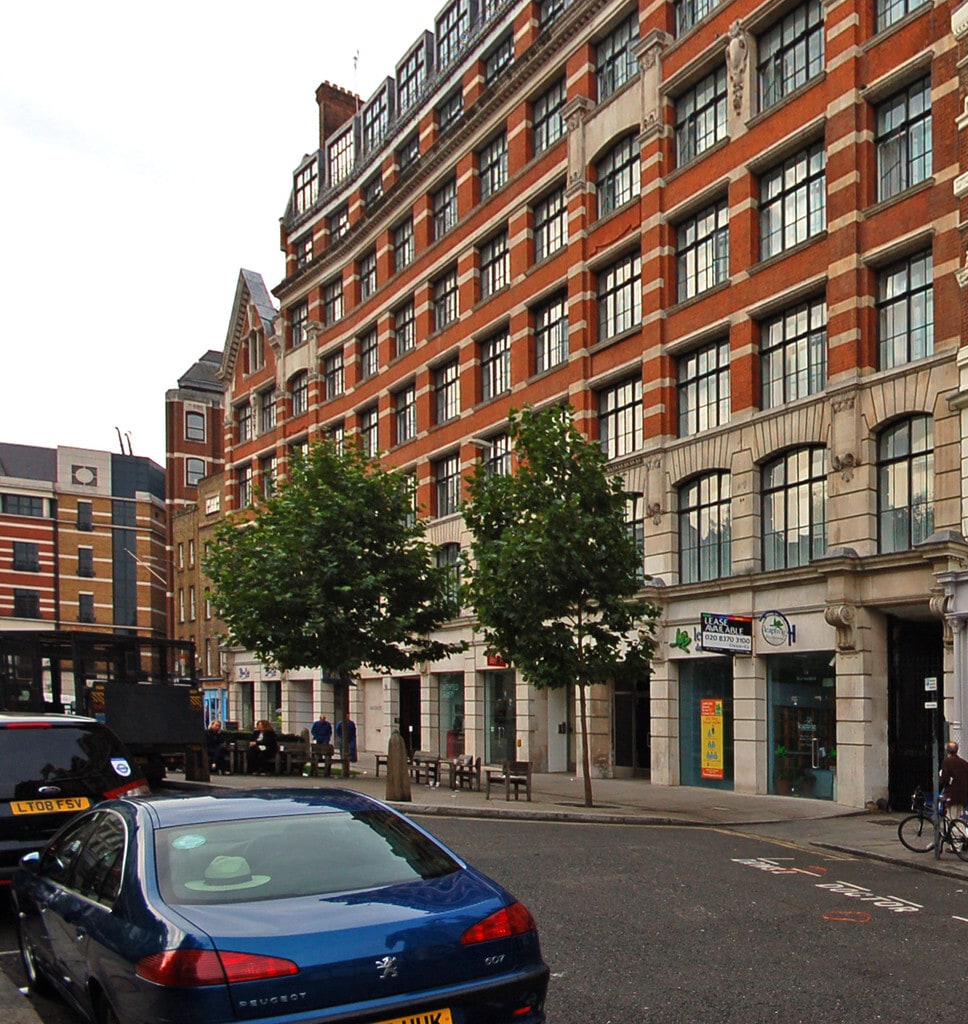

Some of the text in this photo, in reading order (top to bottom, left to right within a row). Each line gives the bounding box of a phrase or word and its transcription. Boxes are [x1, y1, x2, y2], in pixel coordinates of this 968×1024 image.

[704, 617, 728, 626] LEASE
[705, 624, 744, 635] AVAILABLE
[719, 635, 734, 643] 8370
[735, 636, 751, 644] 3100
[17, 799, 82, 812] LT08 FSV
[485, 954, 505, 966] 607
[239, 992, 307, 1007] PEUGEOT
